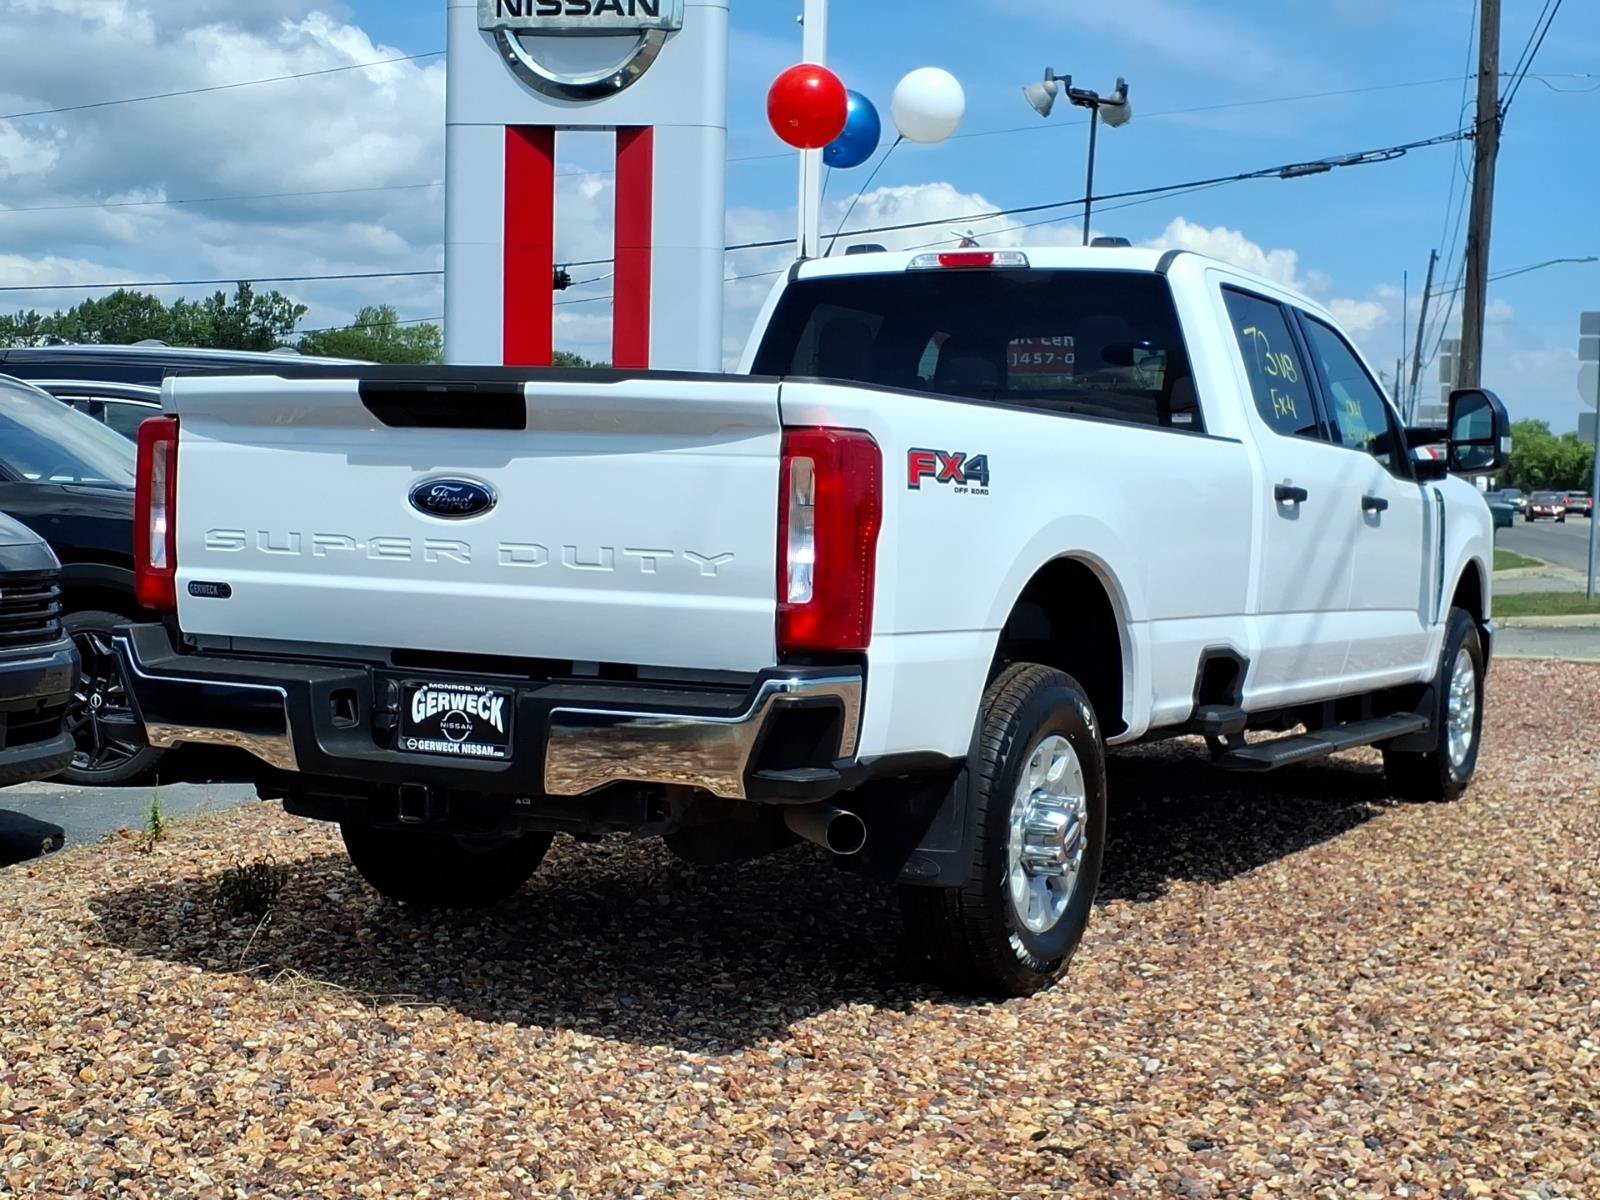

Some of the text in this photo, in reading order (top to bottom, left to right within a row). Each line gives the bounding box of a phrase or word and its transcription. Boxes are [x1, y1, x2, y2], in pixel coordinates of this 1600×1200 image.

[496, 0, 660, 18] NISSAN
[907, 447, 990, 490] FX4
[427, 485, 475, 509] Ford
[205, 528, 735, 576] SUPER DUTY
[412, 688, 504, 734] GERWECK
[440, 722, 473, 731] NISSAN
[418, 741, 460, 754] GERWECK
